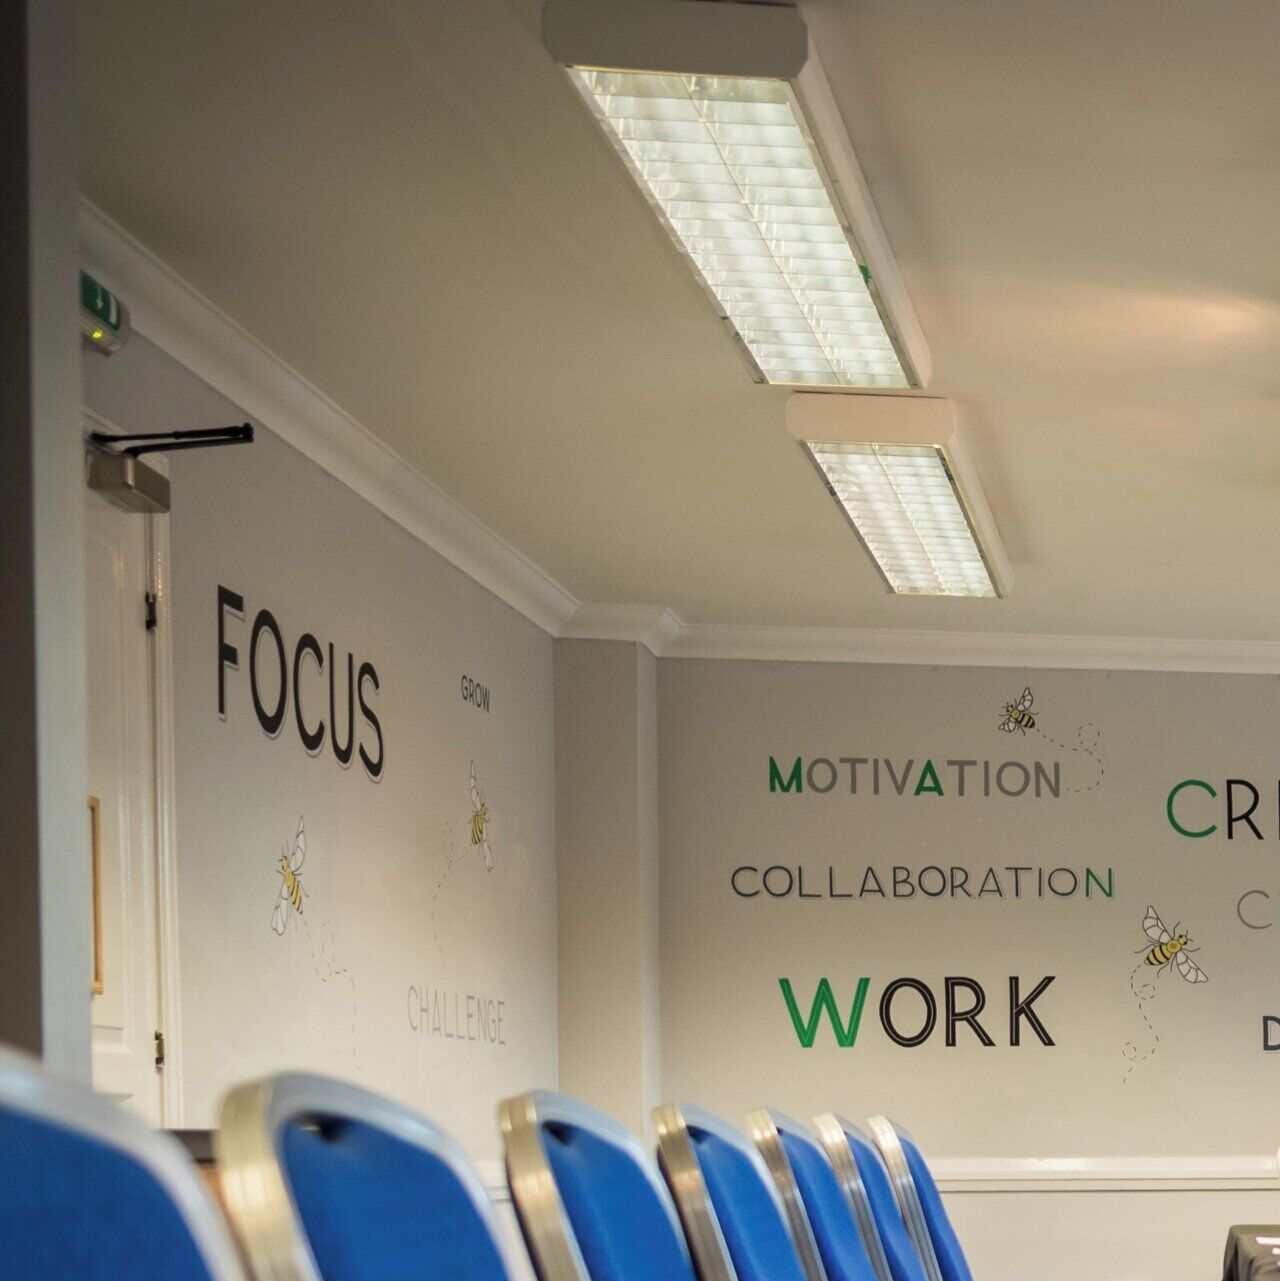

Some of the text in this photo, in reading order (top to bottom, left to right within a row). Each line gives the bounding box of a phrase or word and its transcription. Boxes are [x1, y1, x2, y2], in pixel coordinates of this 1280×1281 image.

[217, 584, 384, 778] FOCUS
[461, 674, 490, 713] GROW
[768, 756, 1061, 798] MOTIVATION
[731, 866, 1114, 899] COLLABORATION
[407, 985, 506, 1045] CHALLENGE
[778, 976, 1056, 1049] WORK
